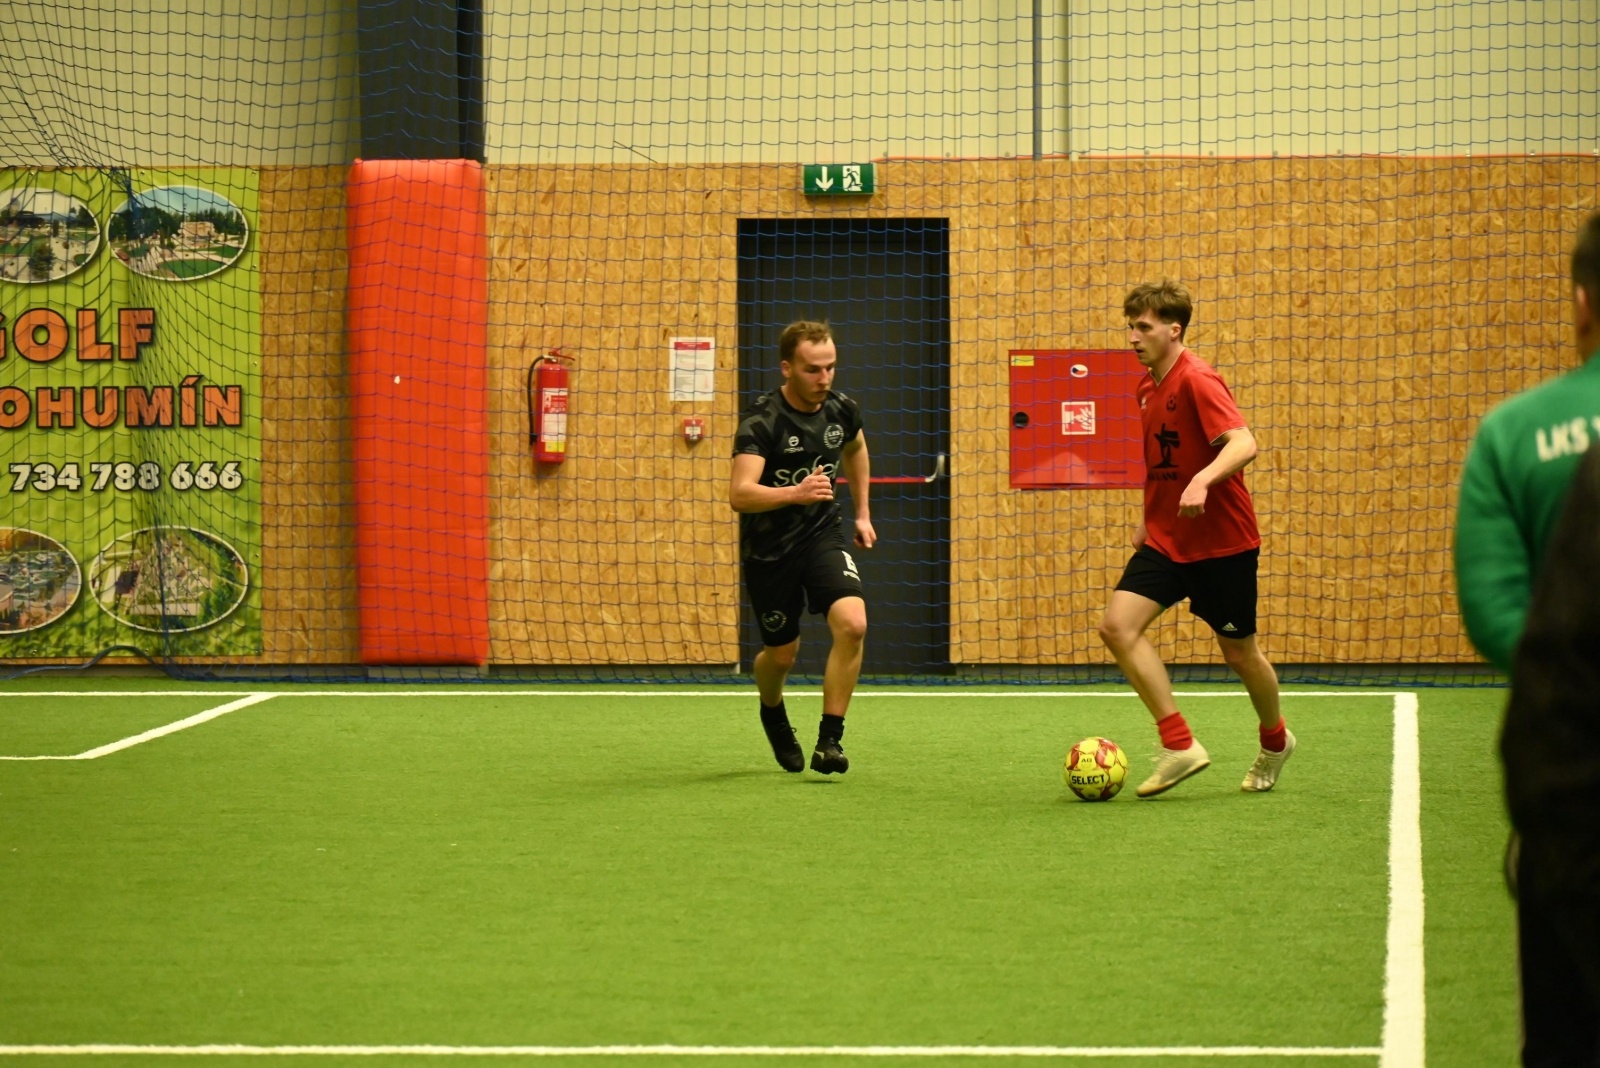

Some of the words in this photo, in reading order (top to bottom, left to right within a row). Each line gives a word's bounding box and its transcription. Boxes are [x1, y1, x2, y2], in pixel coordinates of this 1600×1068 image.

[0, 308, 155, 362] OLF
[0, 375, 243, 429] OHUMÍN
[9, 462, 82, 492] 734
[90, 461, 161, 492] 788
[170, 461, 243, 491] 666
[1071, 774, 1105, 785] SELECT
